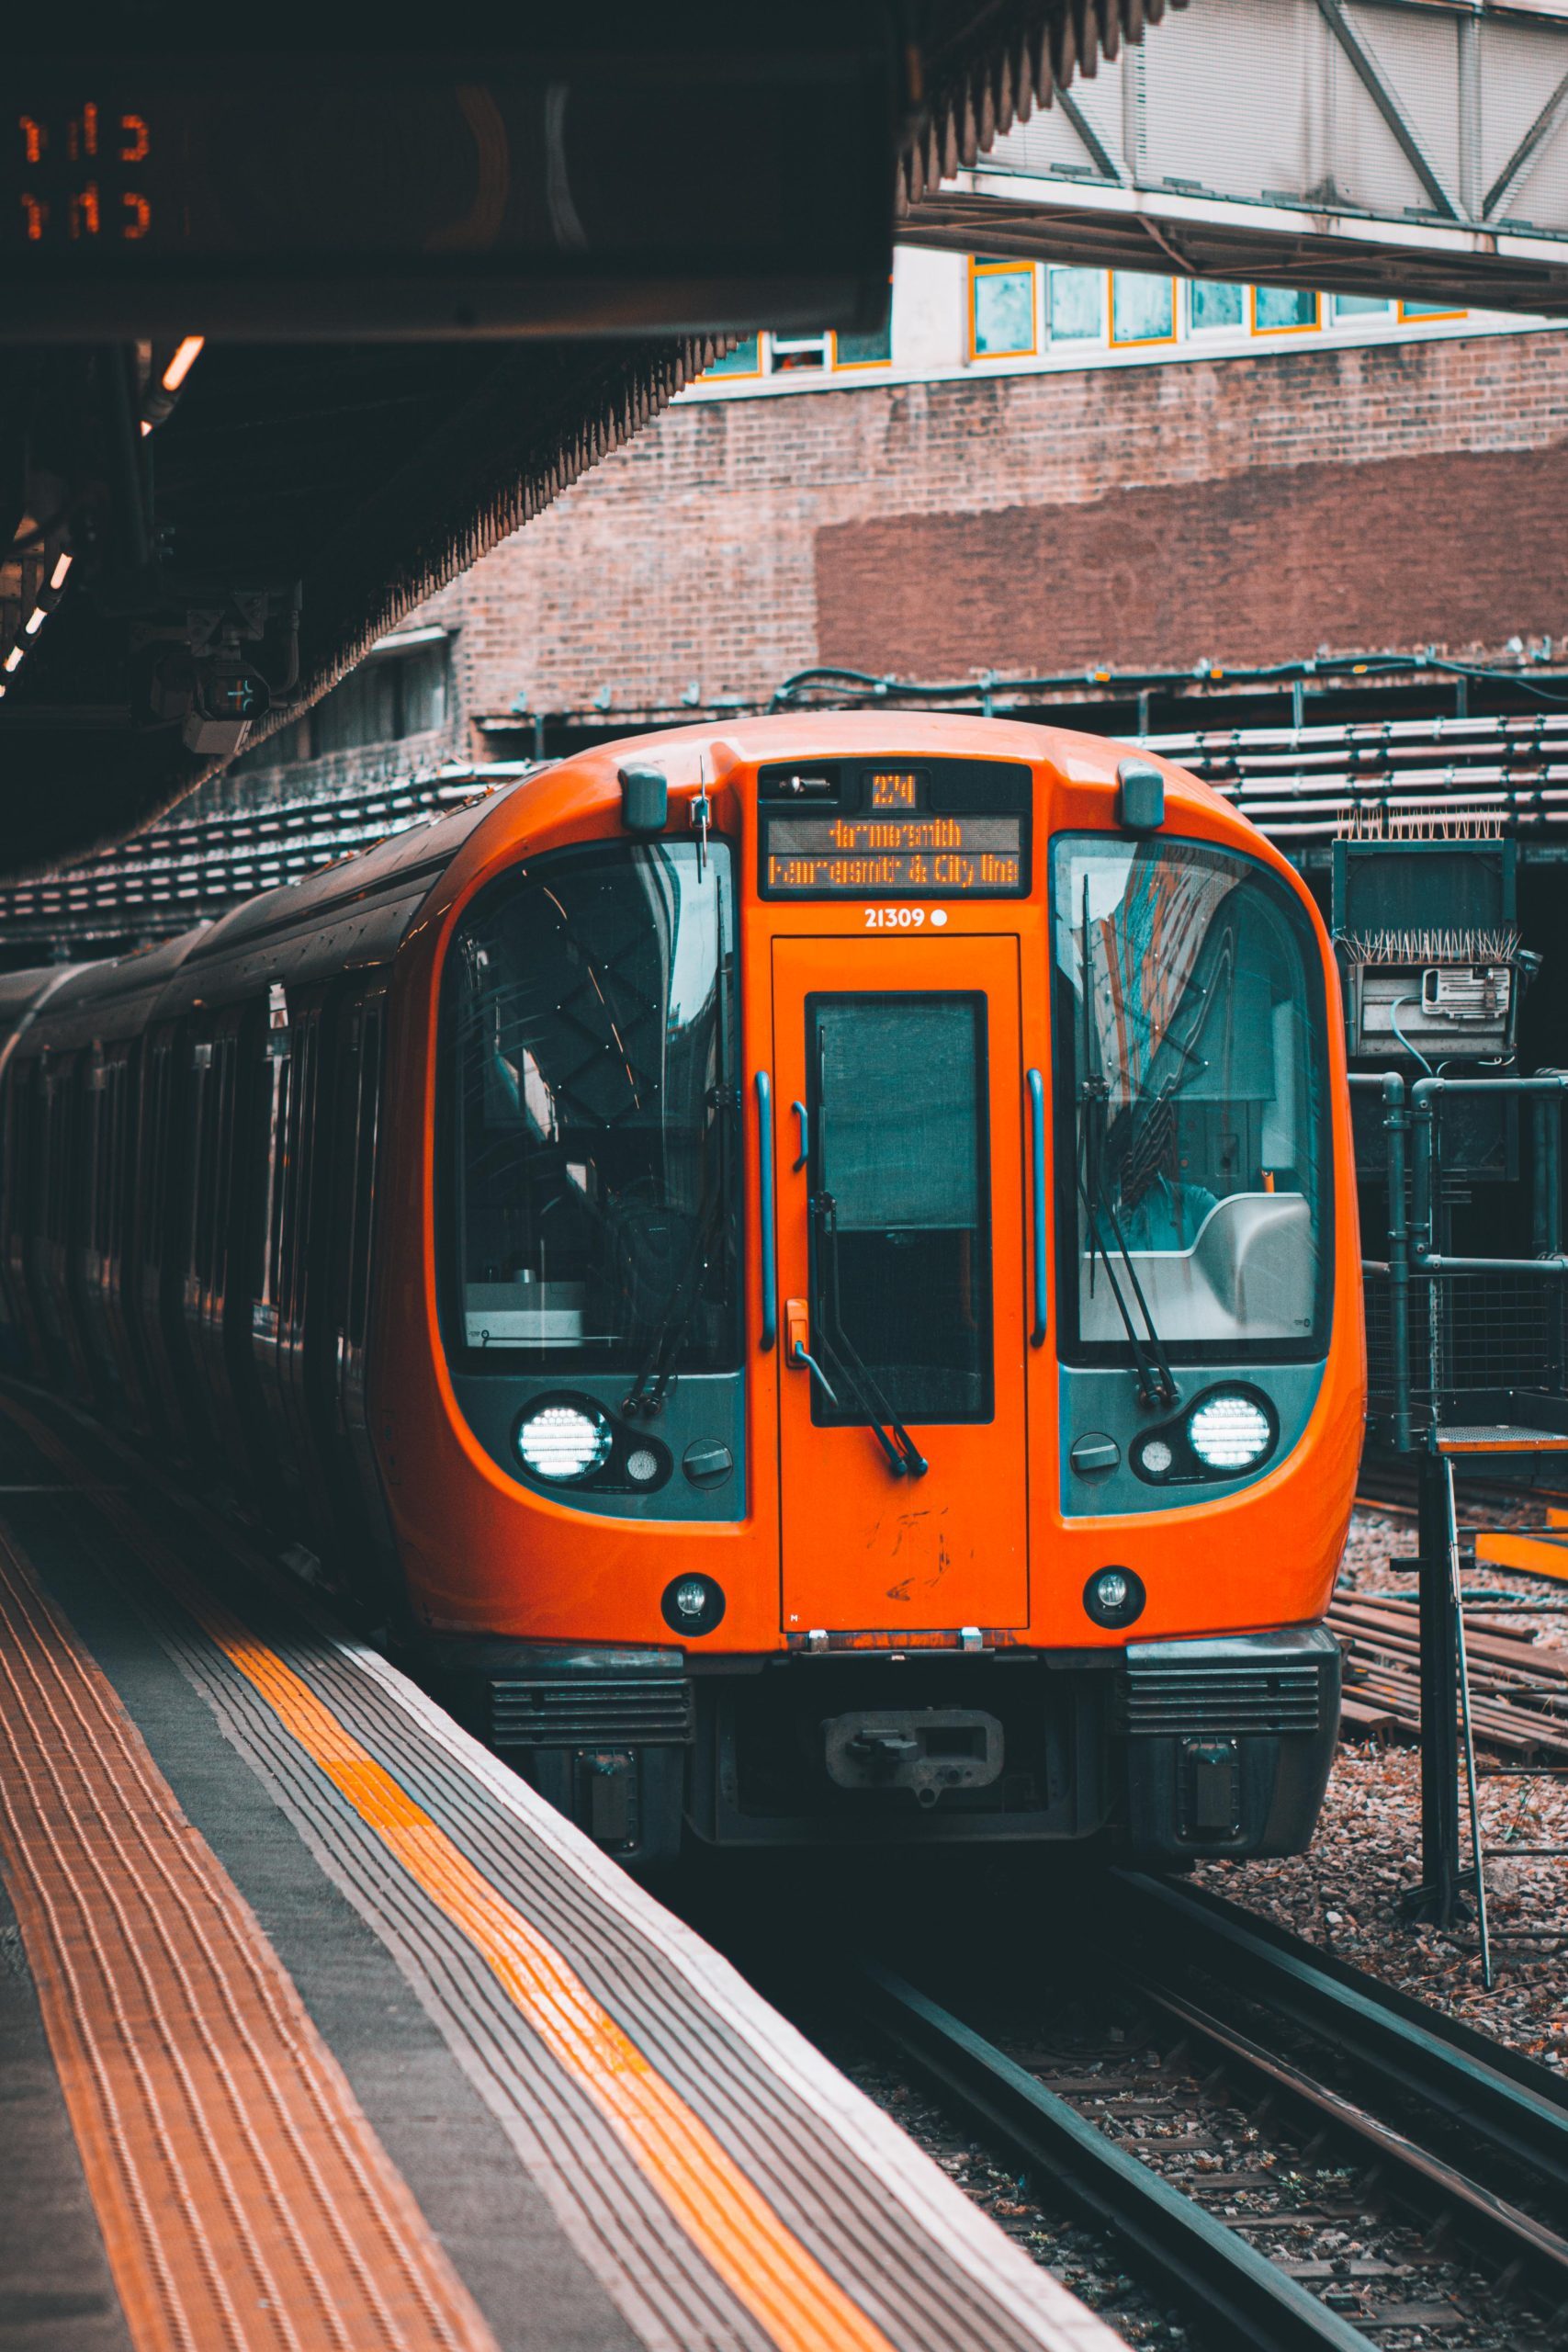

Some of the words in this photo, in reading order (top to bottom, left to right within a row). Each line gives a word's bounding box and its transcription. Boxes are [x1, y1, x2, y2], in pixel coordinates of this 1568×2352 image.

[908, 854, 929, 884] &
[933, 854, 976, 889] City
[864, 909, 925, 927] 21309
